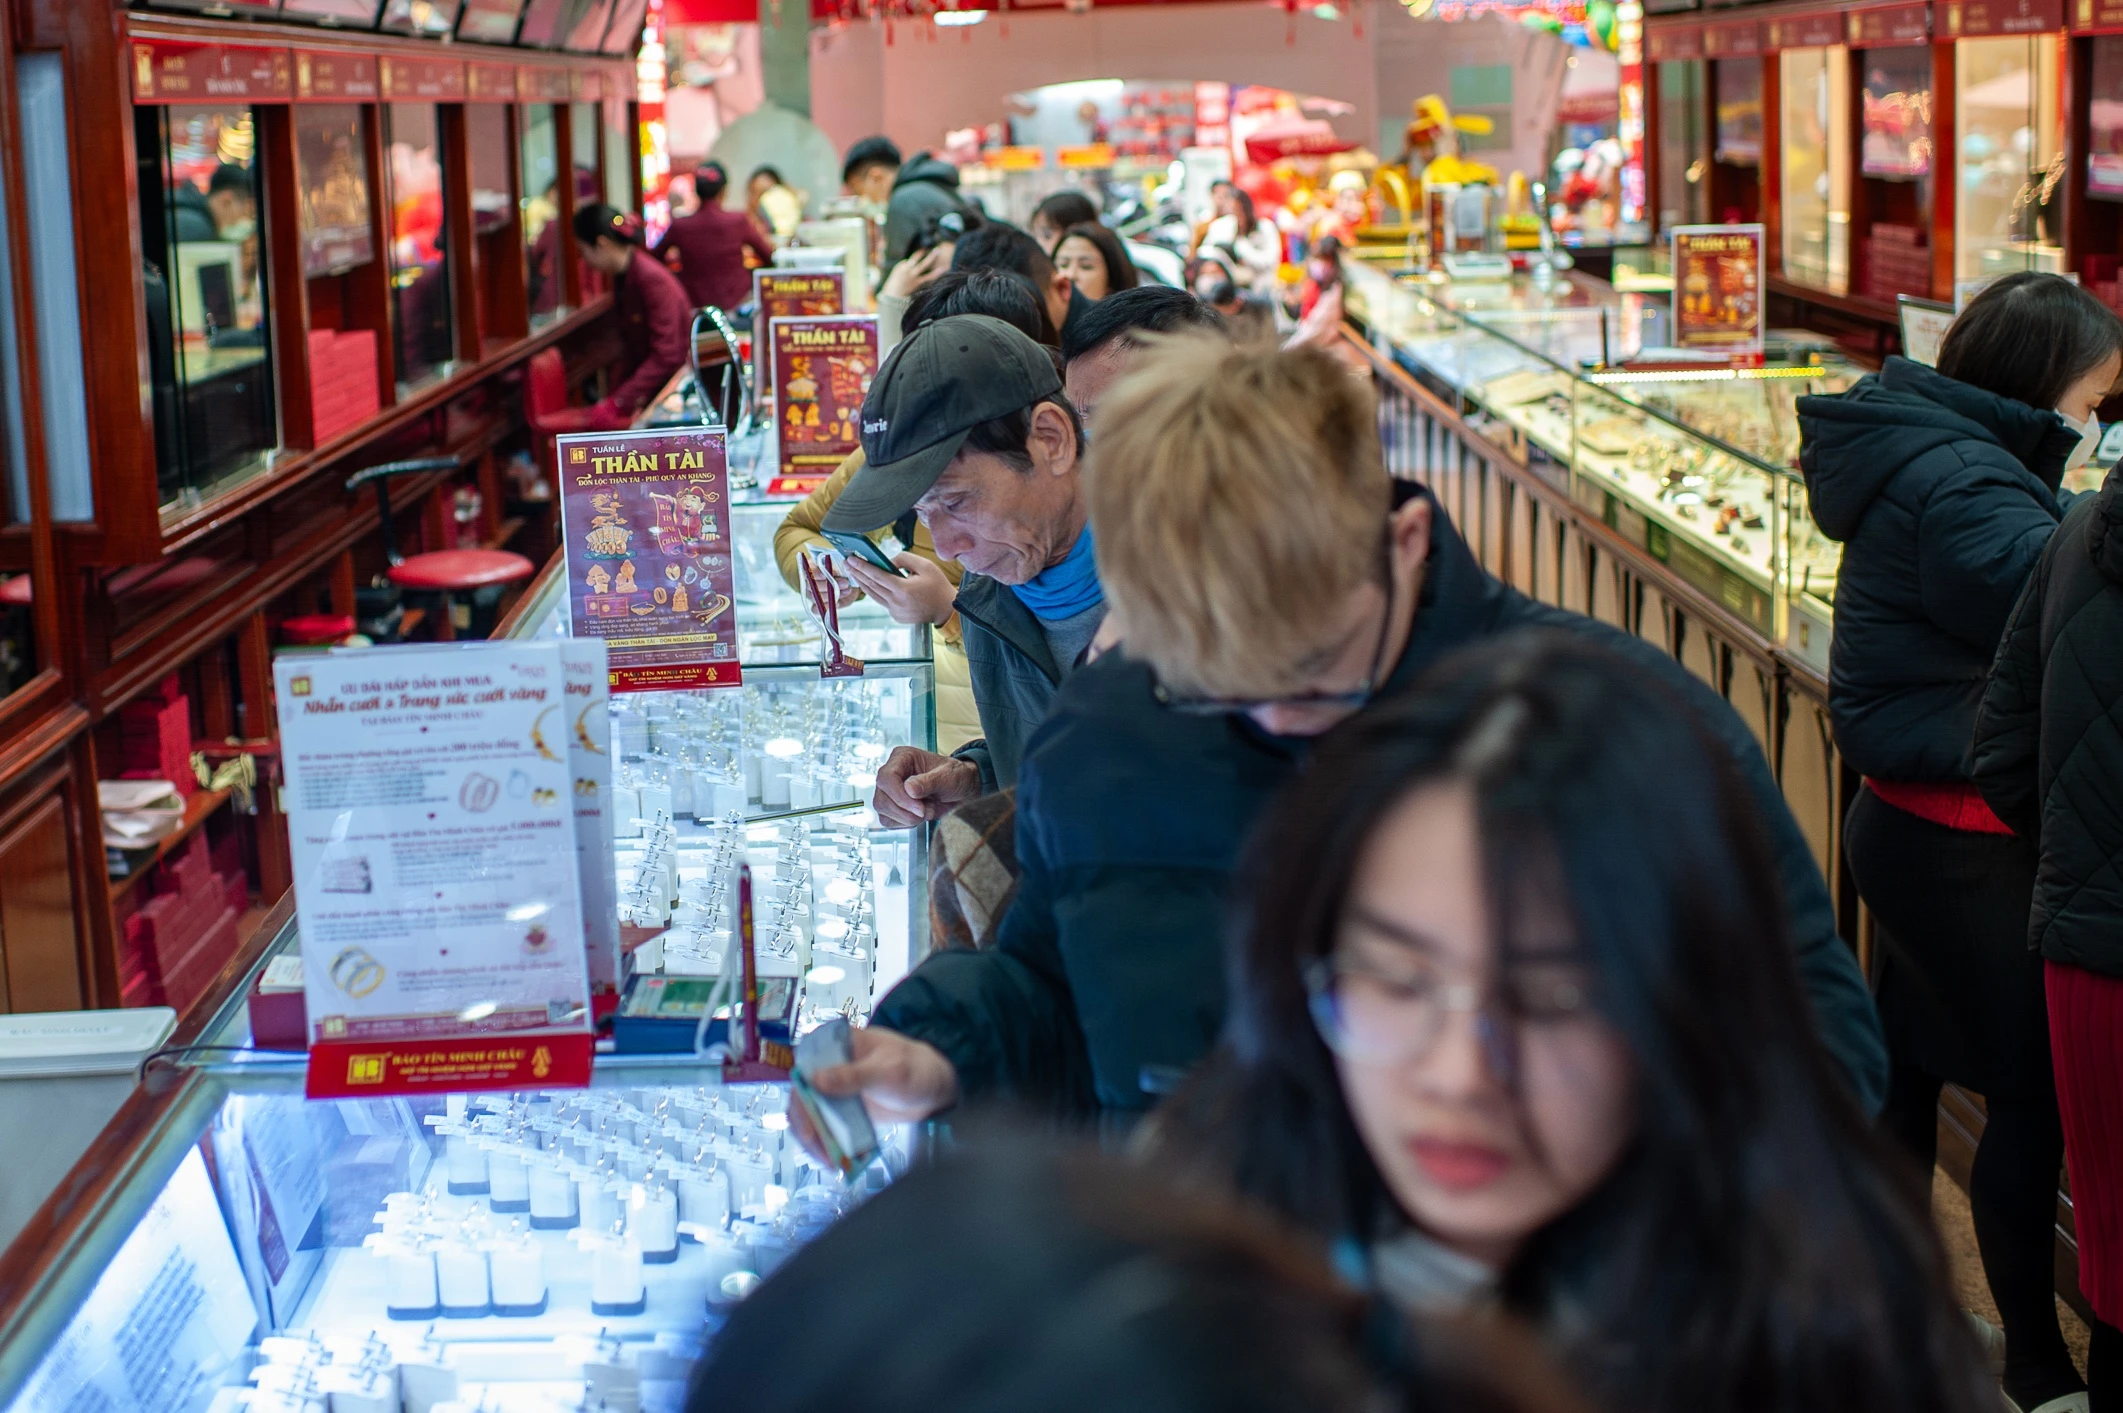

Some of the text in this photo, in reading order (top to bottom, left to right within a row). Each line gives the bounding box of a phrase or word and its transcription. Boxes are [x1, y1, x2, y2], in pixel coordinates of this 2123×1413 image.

[839, 328, 866, 344] TÀI
[591, 448, 704, 475] THẦN TÀI
[594, 478, 608, 487] LỘC
[609, 476, 628, 485] THẦN
[629, 475, 640, 484] TÀI
[688, 472, 713, 481] KHANG
